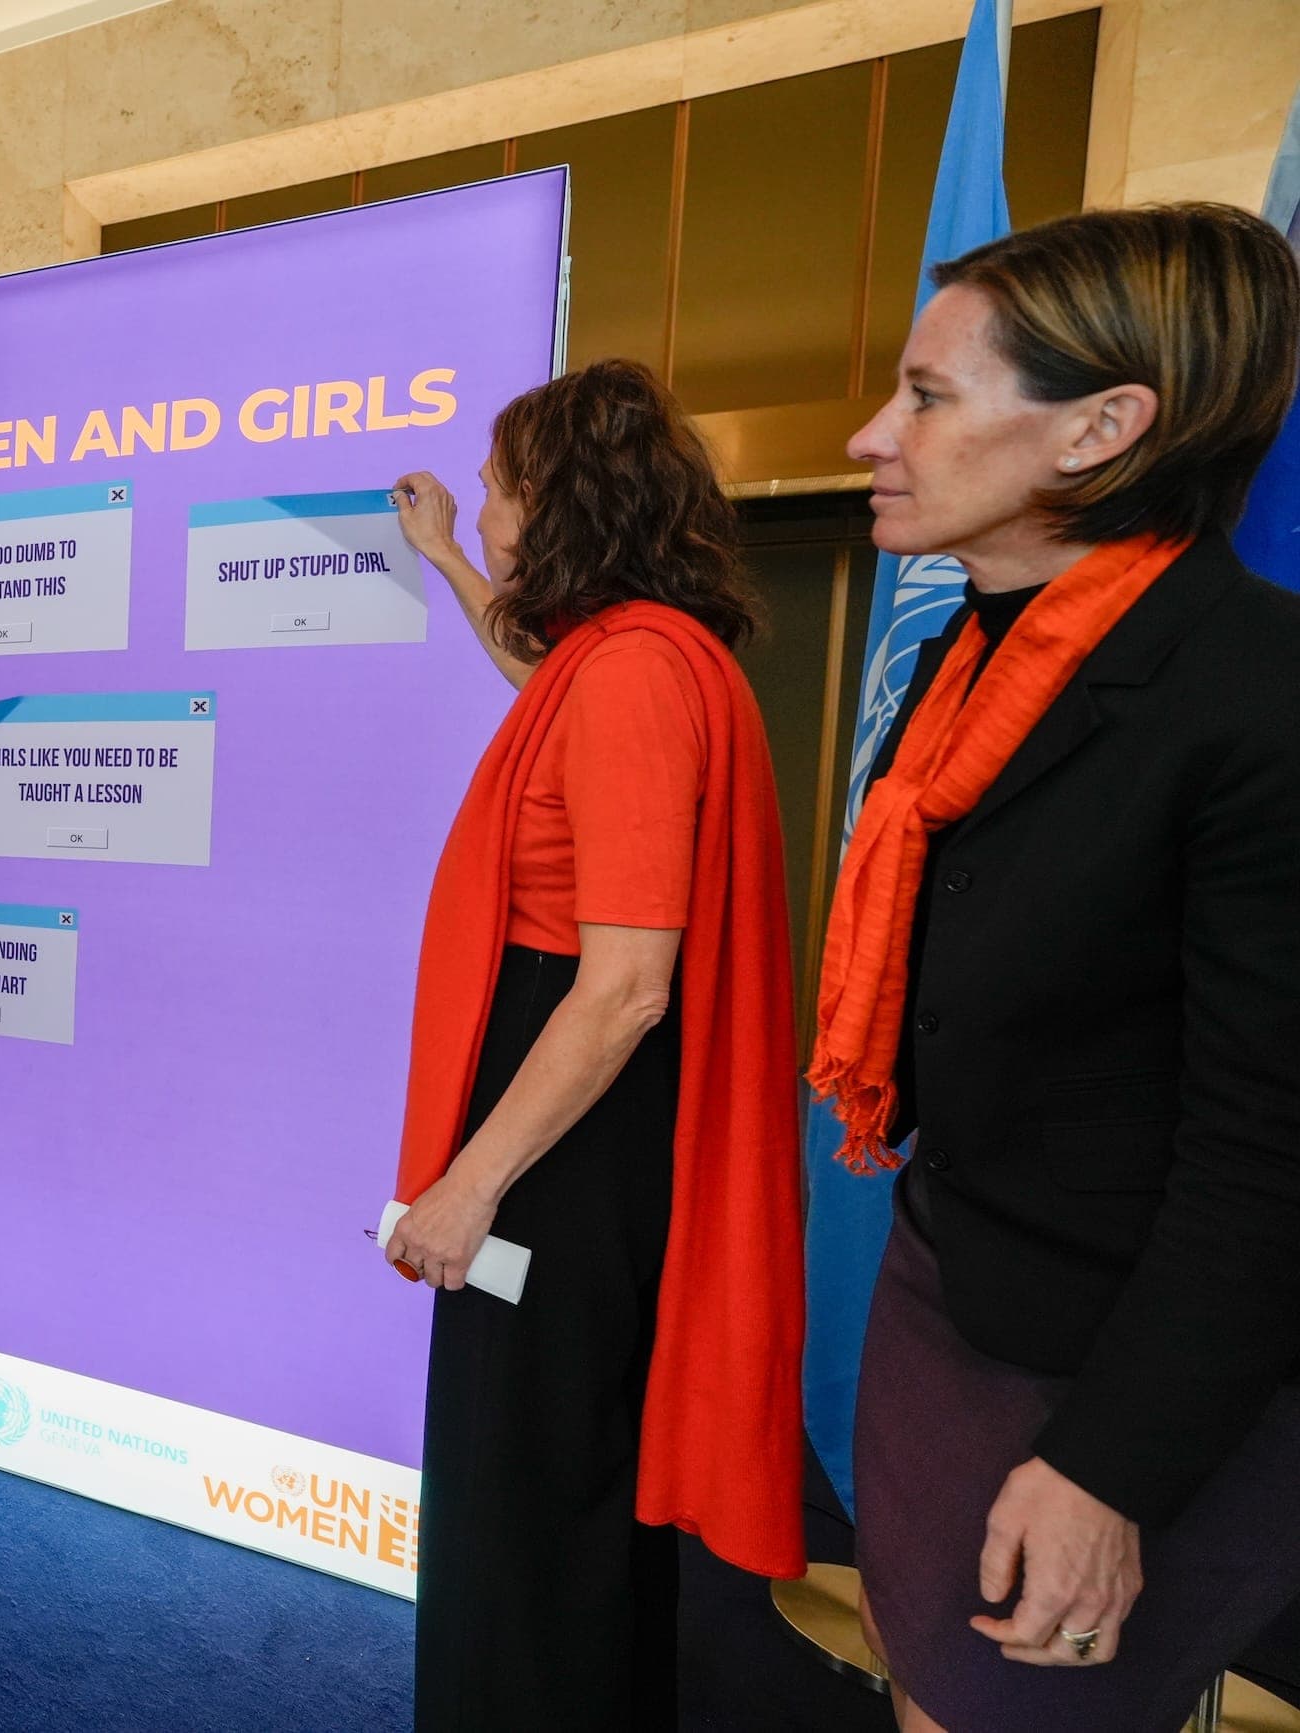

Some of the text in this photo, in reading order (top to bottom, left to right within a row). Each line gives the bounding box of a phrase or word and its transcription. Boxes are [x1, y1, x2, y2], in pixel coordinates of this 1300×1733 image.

[69, 398, 221, 461] AND
[238, 368, 457, 443] GIRLS
[16, 542, 55, 563] DUMB
[59, 539, 77, 560] TO
[218, 552, 390, 583] SHUT UP STUPID GIRL
[35, 576, 66, 597] THIS
[293, 618, 307, 627] OK
[30, 748, 59, 767] LIKE
[64, 748, 91, 767] YOU
[95, 748, 132, 767] NEED
[137, 748, 155, 768] TO
[159, 748, 179, 768] BE
[19, 783, 143, 804] TAUGHT A LESSON
[69, 834, 84, 843] OK
[41, 1408, 189, 1465] UNITED NATIONS
[310, 1474, 370, 1520] UN
[204, 1475, 368, 1556] WOMEN
